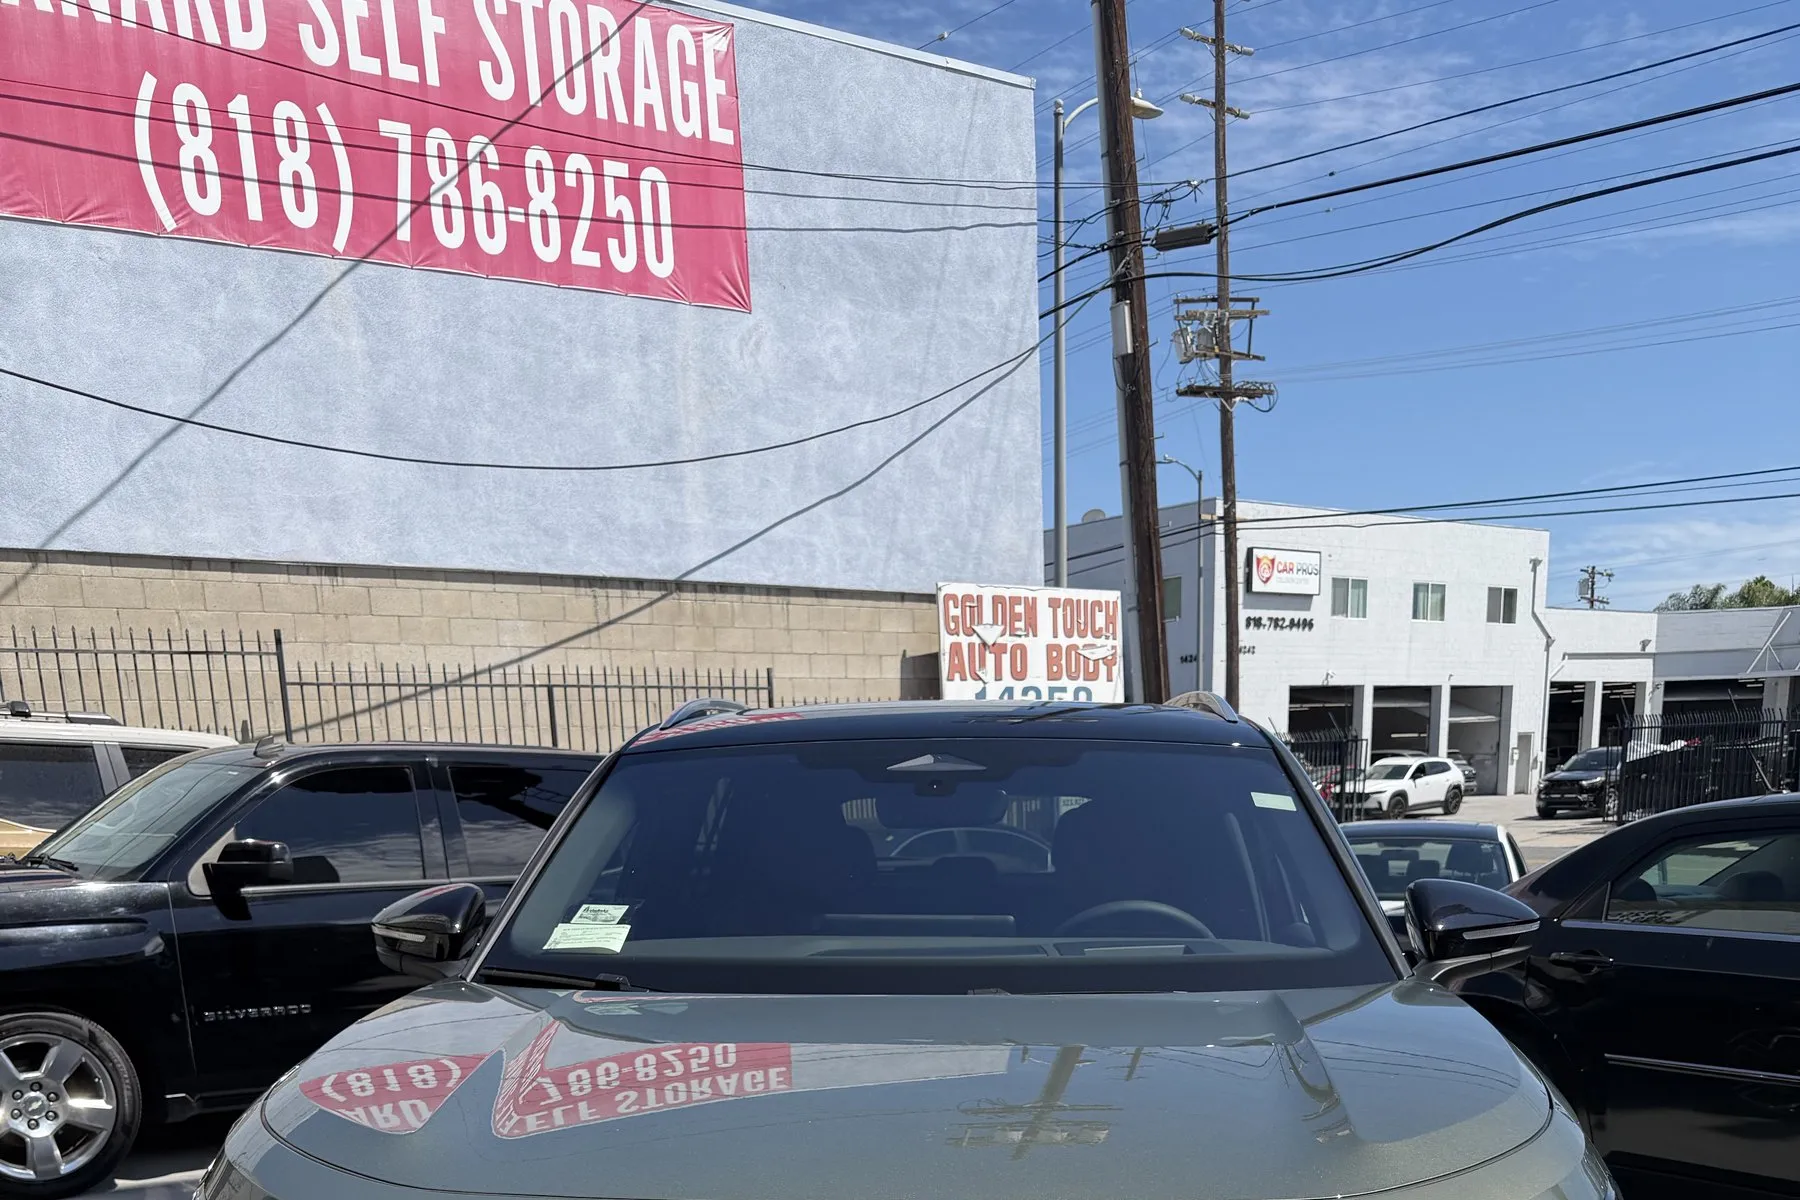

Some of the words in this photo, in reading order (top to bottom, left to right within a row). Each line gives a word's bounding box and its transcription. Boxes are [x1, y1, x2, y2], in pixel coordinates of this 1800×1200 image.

[298, 0, 446, 87] SELF
[479, 0, 735, 146] STORAGE
[134, 71, 354, 252] (818)
[379, 119, 675, 279] 786-8250
[1277, 561, 1295, 574] CAR
[1296, 562, 1319, 576] PROS
[943, 593, 1038, 637] GOLDEN
[1048, 597, 1118, 640] TOUCH
[946, 642, 1028, 682] AUTO
[1046, 643, 1117, 682] BODY
[203, 1004, 311, 1022] SILVERADO
